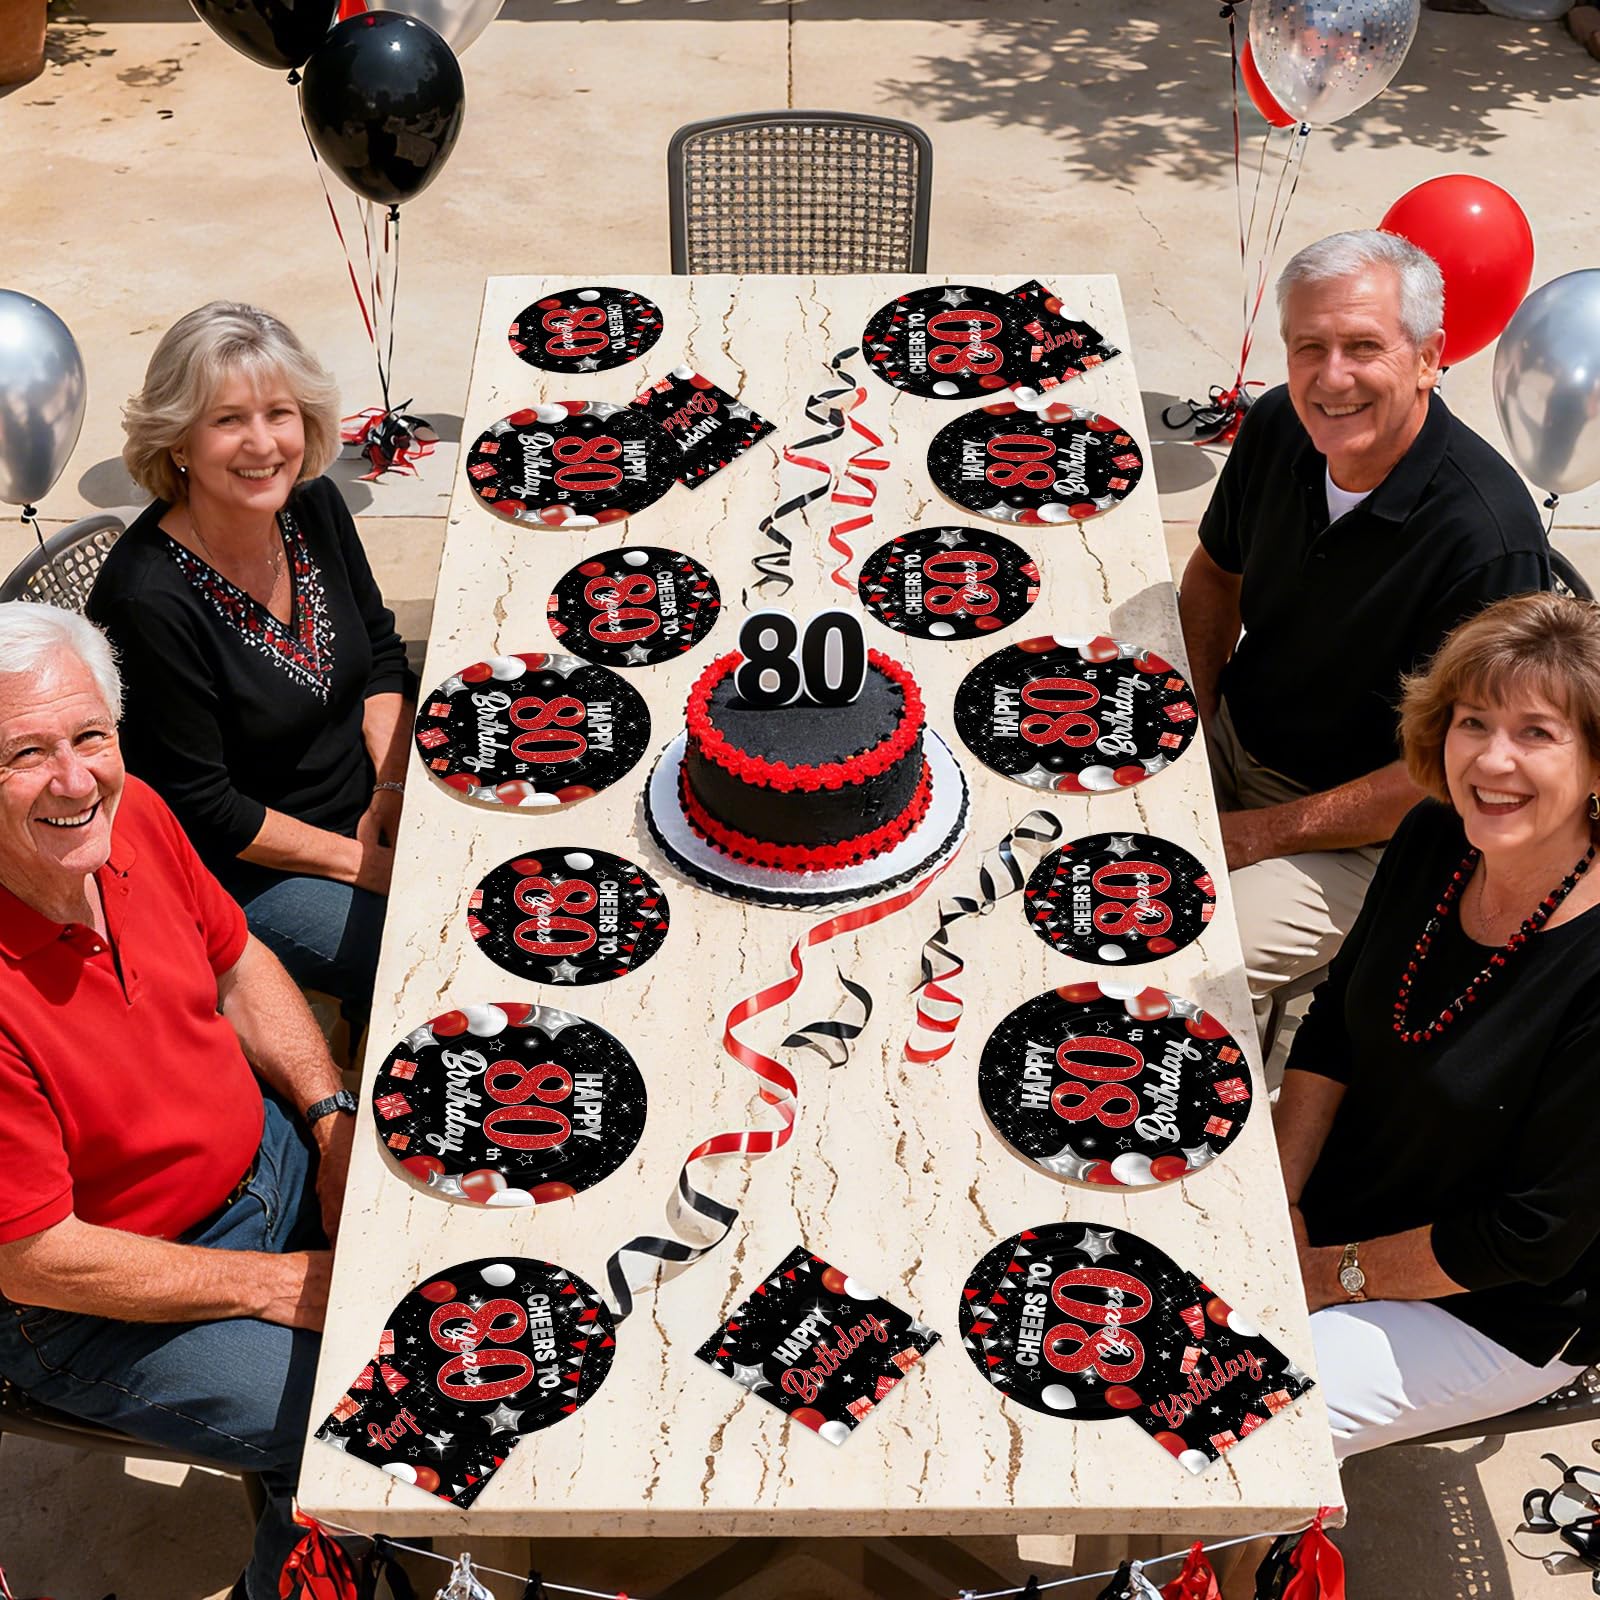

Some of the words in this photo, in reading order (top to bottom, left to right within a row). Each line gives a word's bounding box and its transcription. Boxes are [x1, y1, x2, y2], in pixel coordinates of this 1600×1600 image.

[542, 307, 609, 356] 80
[551, 318, 574, 350] Years
[607, 304, 624, 337] CHEERS
[611, 338, 626, 349] TO
[908, 313, 926, 330] TO
[927, 310, 1004, 374] 80
[966, 319, 993, 362] Years
[909, 332, 927, 374] CHEERS
[510, 432, 554, 499] Birthday
[623, 440, 647, 481] HAPPY
[962, 440, 985, 481] HAPPY
[1053, 431, 1100, 495] Birthday
[904, 554, 922, 569] TO
[923, 551, 1000, 615] 80
[962, 560, 989, 603] Years
[584, 574, 661, 643] 80
[594, 589, 620, 633] Years
[657, 571, 677, 617] CHEERS
[905, 571, 923, 615] CHEERS
[662, 617, 680, 635] TO
[735, 609, 867, 705] 80
[463, 691, 512, 772] Birthday
[587, 701, 614, 752] HAPPY
[993, 684, 1019, 738] HAPPY
[1096, 673, 1150, 756] Birthday
[1073, 865, 1090, 883] TO
[1092, 861, 1173, 936] 80
[1133, 872, 1162, 921] Years
[513, 876, 598, 956] 80
[525, 892, 555, 944] Years
[599, 880, 619, 933] CHEERS
[1073, 885, 1092, 936] CHEERS
[599, 935, 618, 954] TO
[1020, 1040, 1055, 1110] HAPPY
[1135, 1037, 1202, 1143] Birthday
[426, 1049, 487, 1156] Birthday
[572, 1073, 603, 1141] HAPPY
[1029, 1262, 1053, 1287] TO
[526, 1294, 556, 1362] CHEERS
[771, 1307, 832, 1367] HAPPY
[1015, 1290, 1048, 1366] CHEERS
[1043, 1267, 1152, 1383] 80
[1095, 1286, 1132, 1358] Years
[429, 1298, 534, 1401] 80
[443, 1320, 479, 1388] Years
[536, 1363, 561, 1389] TO
[781, 1313, 890, 1404] Birthday
[1150, 1349, 1268, 1429] Birthday
